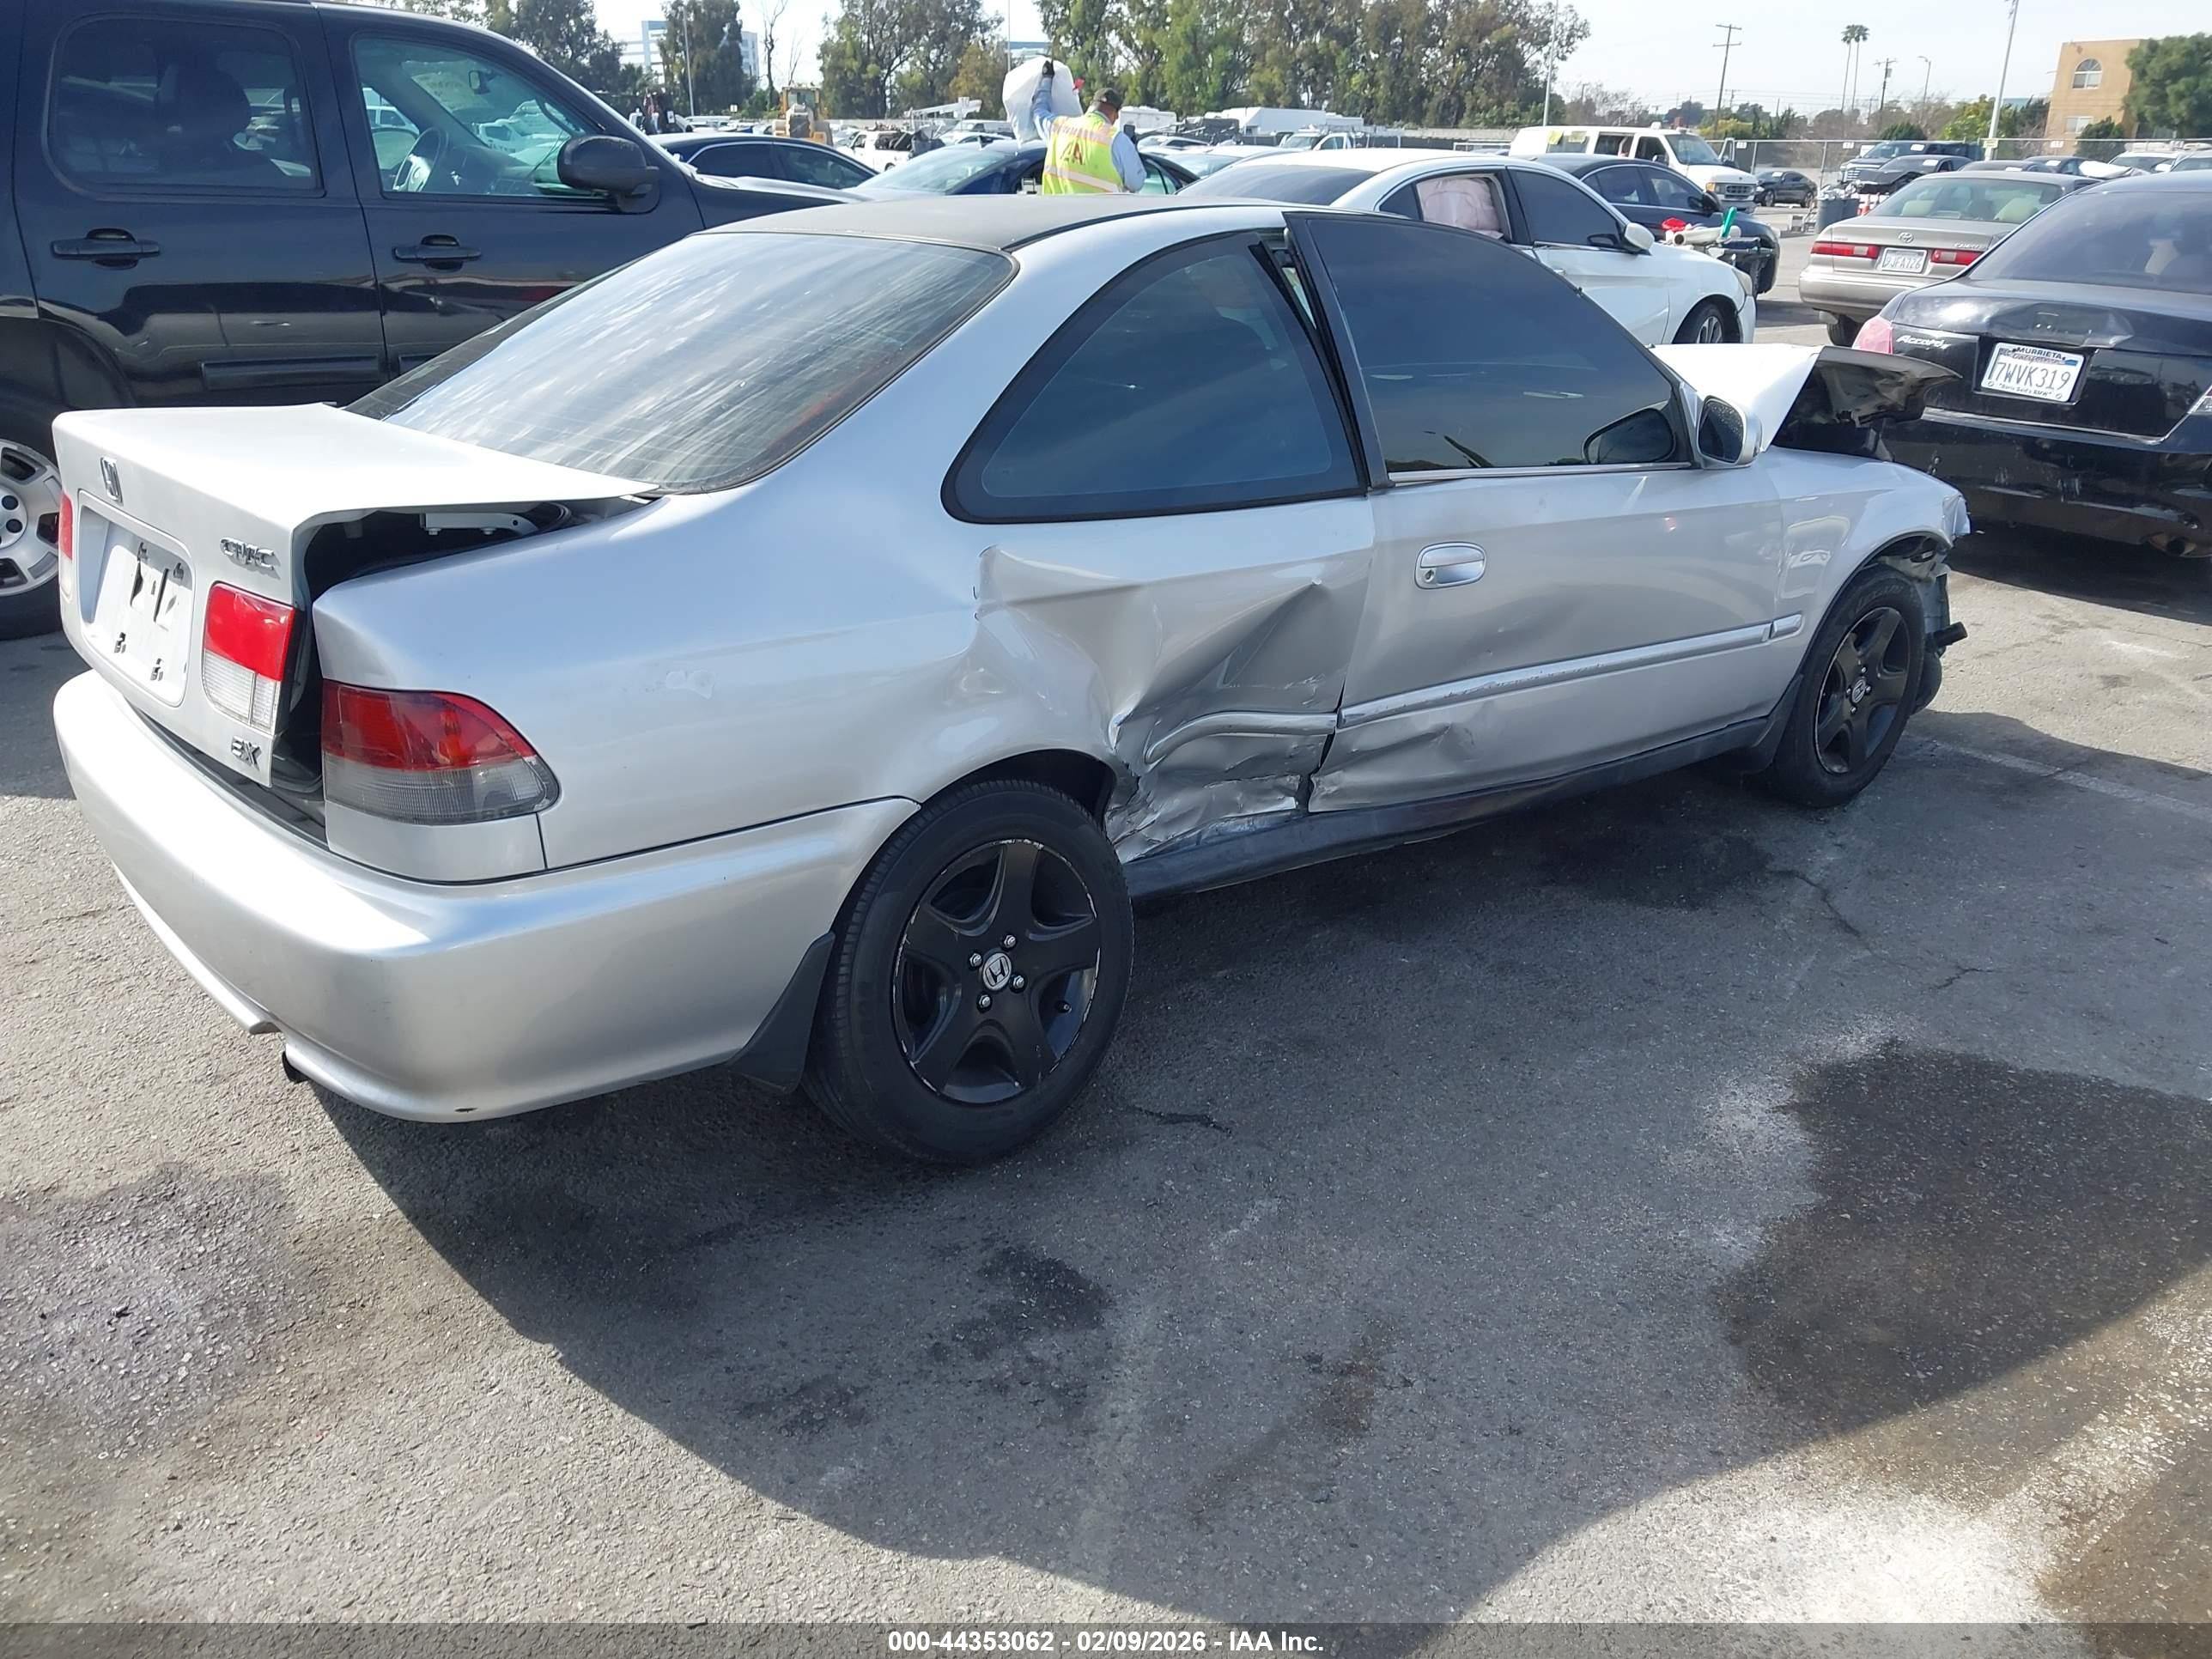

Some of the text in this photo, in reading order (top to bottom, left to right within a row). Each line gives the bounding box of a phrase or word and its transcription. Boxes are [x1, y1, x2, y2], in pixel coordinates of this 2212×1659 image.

[1896, 335, 1945, 347] Accord
[2017, 347, 2062, 360] MURRIETA
[1995, 362, 2071, 391] 7WVK319
[232, 736, 261, 764] EX
